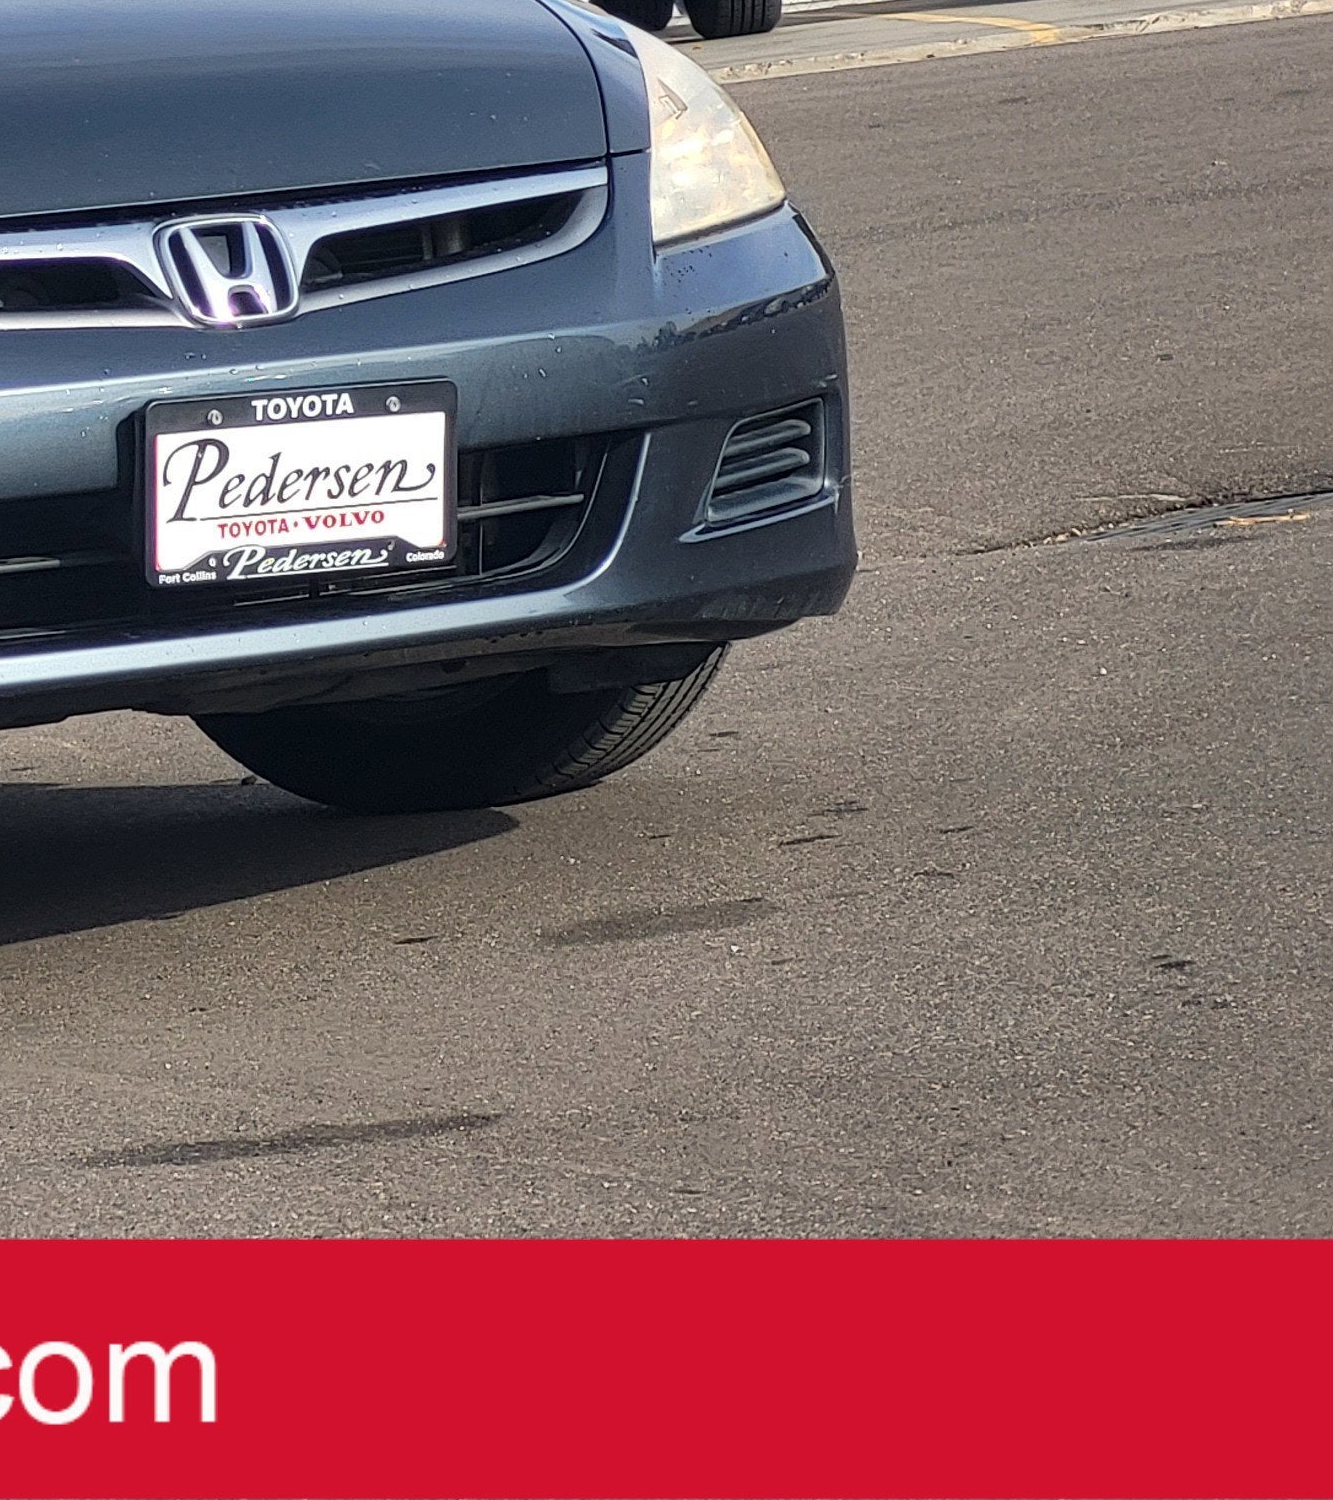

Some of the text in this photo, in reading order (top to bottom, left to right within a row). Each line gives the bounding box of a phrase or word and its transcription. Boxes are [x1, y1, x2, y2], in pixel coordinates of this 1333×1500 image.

[251, 392, 354, 422] TOYOTA
[162, 438, 436, 524] Pedersen
[217, 509, 385, 540] TOYOTA VOLVO
[223, 546, 388, 581] Pedersen
[406, 550, 445, 563] Colorado
[159, 569, 217, 585] Fort Collins
